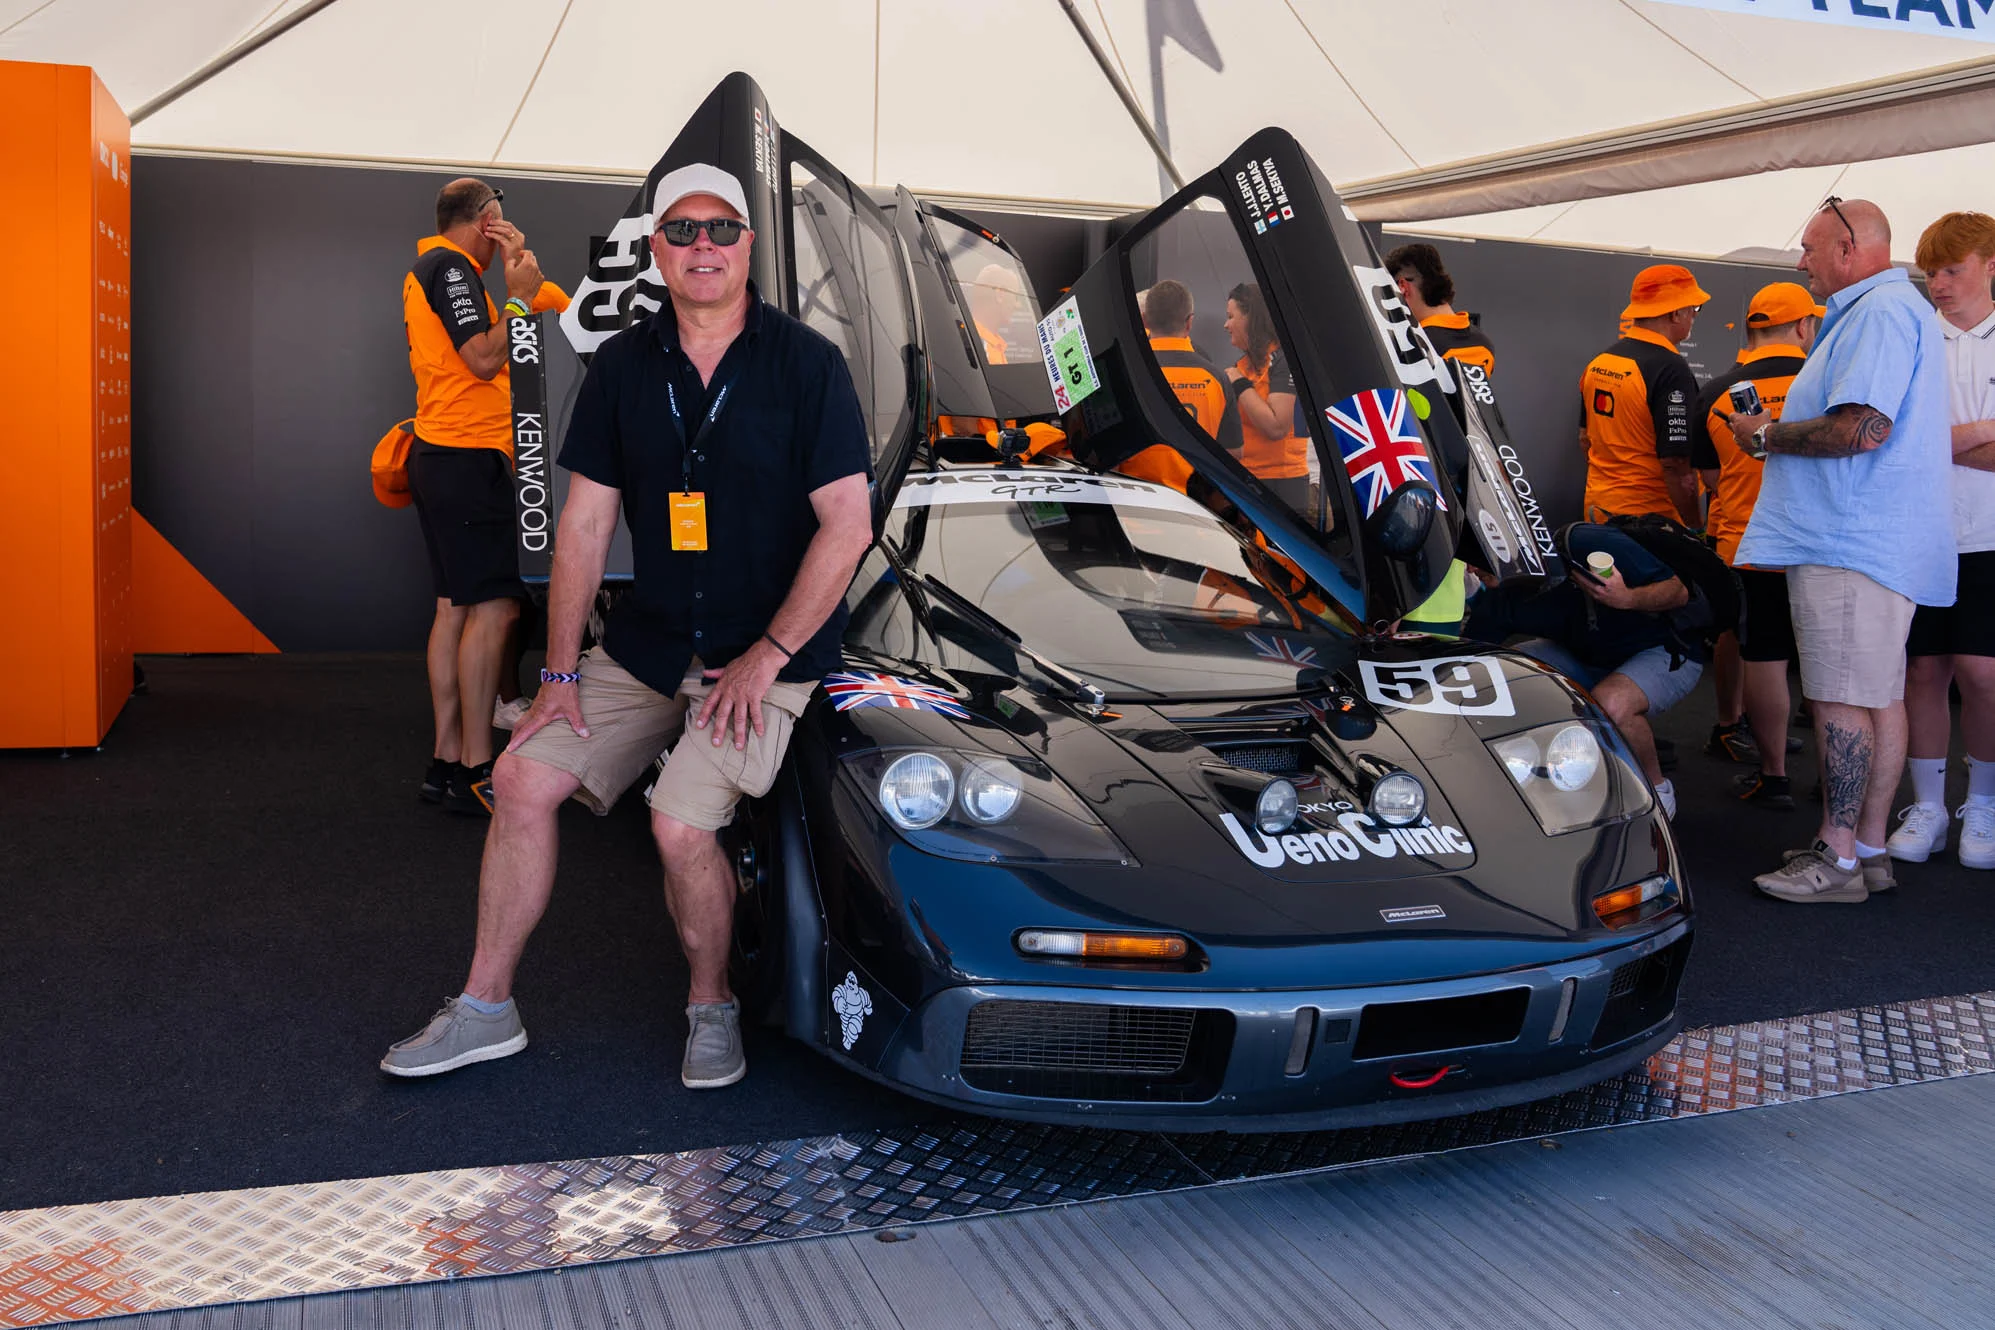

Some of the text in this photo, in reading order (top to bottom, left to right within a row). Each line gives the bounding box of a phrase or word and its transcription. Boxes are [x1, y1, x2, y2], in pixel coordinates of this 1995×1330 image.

[1236, 171, 1261, 217] J.J.LEHTO
[1247, 160, 1274, 212] Y.DALMAS
[1262, 157, 1289, 205] M.SEKIYA
[452, 297, 472, 309] okta
[455, 308, 476, 318] FxPro
[511, 317, 539, 364] asics
[1372, 284, 1435, 369] 59
[1037, 323, 1071, 409] 24 HEURES DU MANS
[1063, 347, 1074, 359] 1
[1068, 363, 1082, 385] GT
[1464, 366, 1494, 405] asics
[1591, 367, 1624, 380] McLaren
[516, 412, 548, 551] KENWOOD
[901, 473, 1158, 494] McLaren
[990, 484, 1081, 500] GTR
[1499, 445, 1558, 557] KENWOOD
[1373, 660, 1498, 707] 59
[1298, 801, 1354, 813] OKYO
[1388, 909, 1440, 919] McLaren
